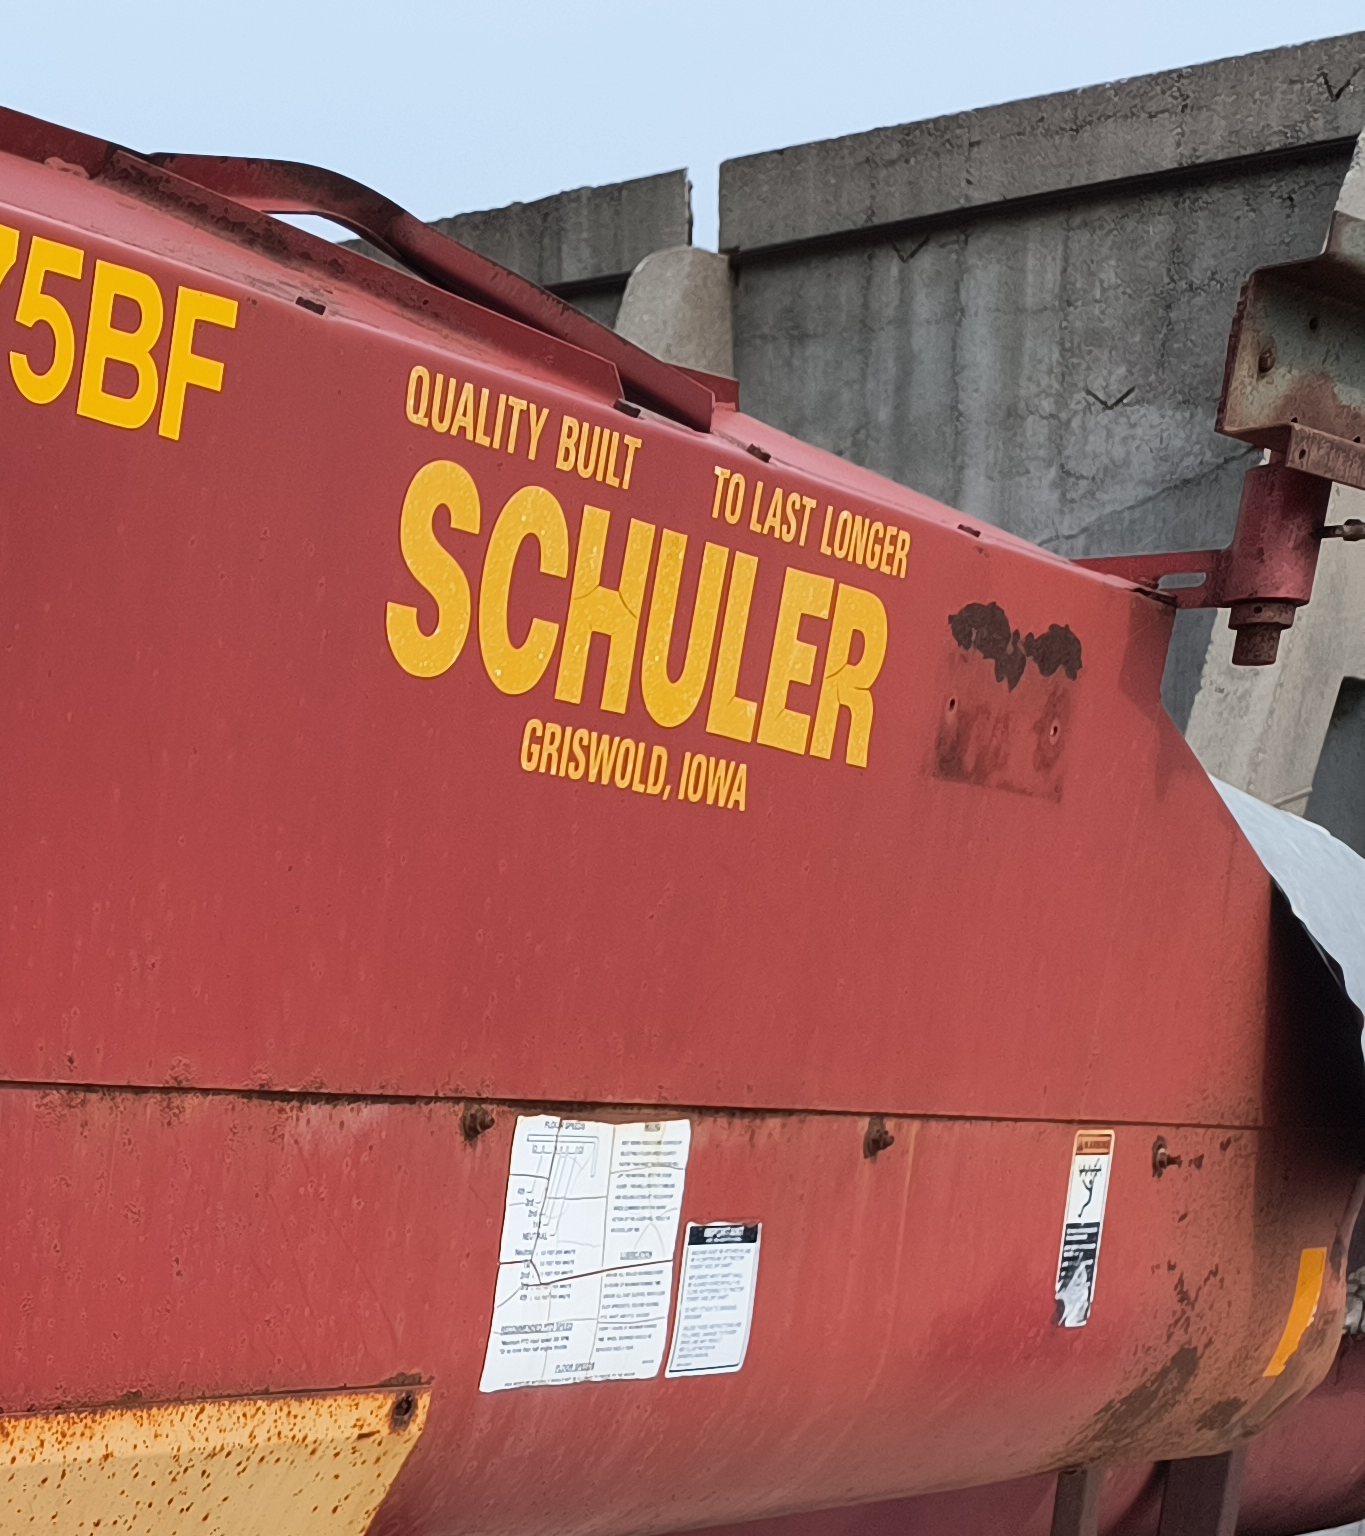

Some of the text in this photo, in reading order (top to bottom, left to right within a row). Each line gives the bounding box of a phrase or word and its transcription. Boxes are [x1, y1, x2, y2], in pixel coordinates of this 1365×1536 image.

[405, 365, 642, 489] QUALITY BUILT
[714, 465, 912, 579] TO LAST LONGER
[385, 459, 888, 768] SCHULER
[520, 719, 747, 812] GRISWOLD, IOWA
